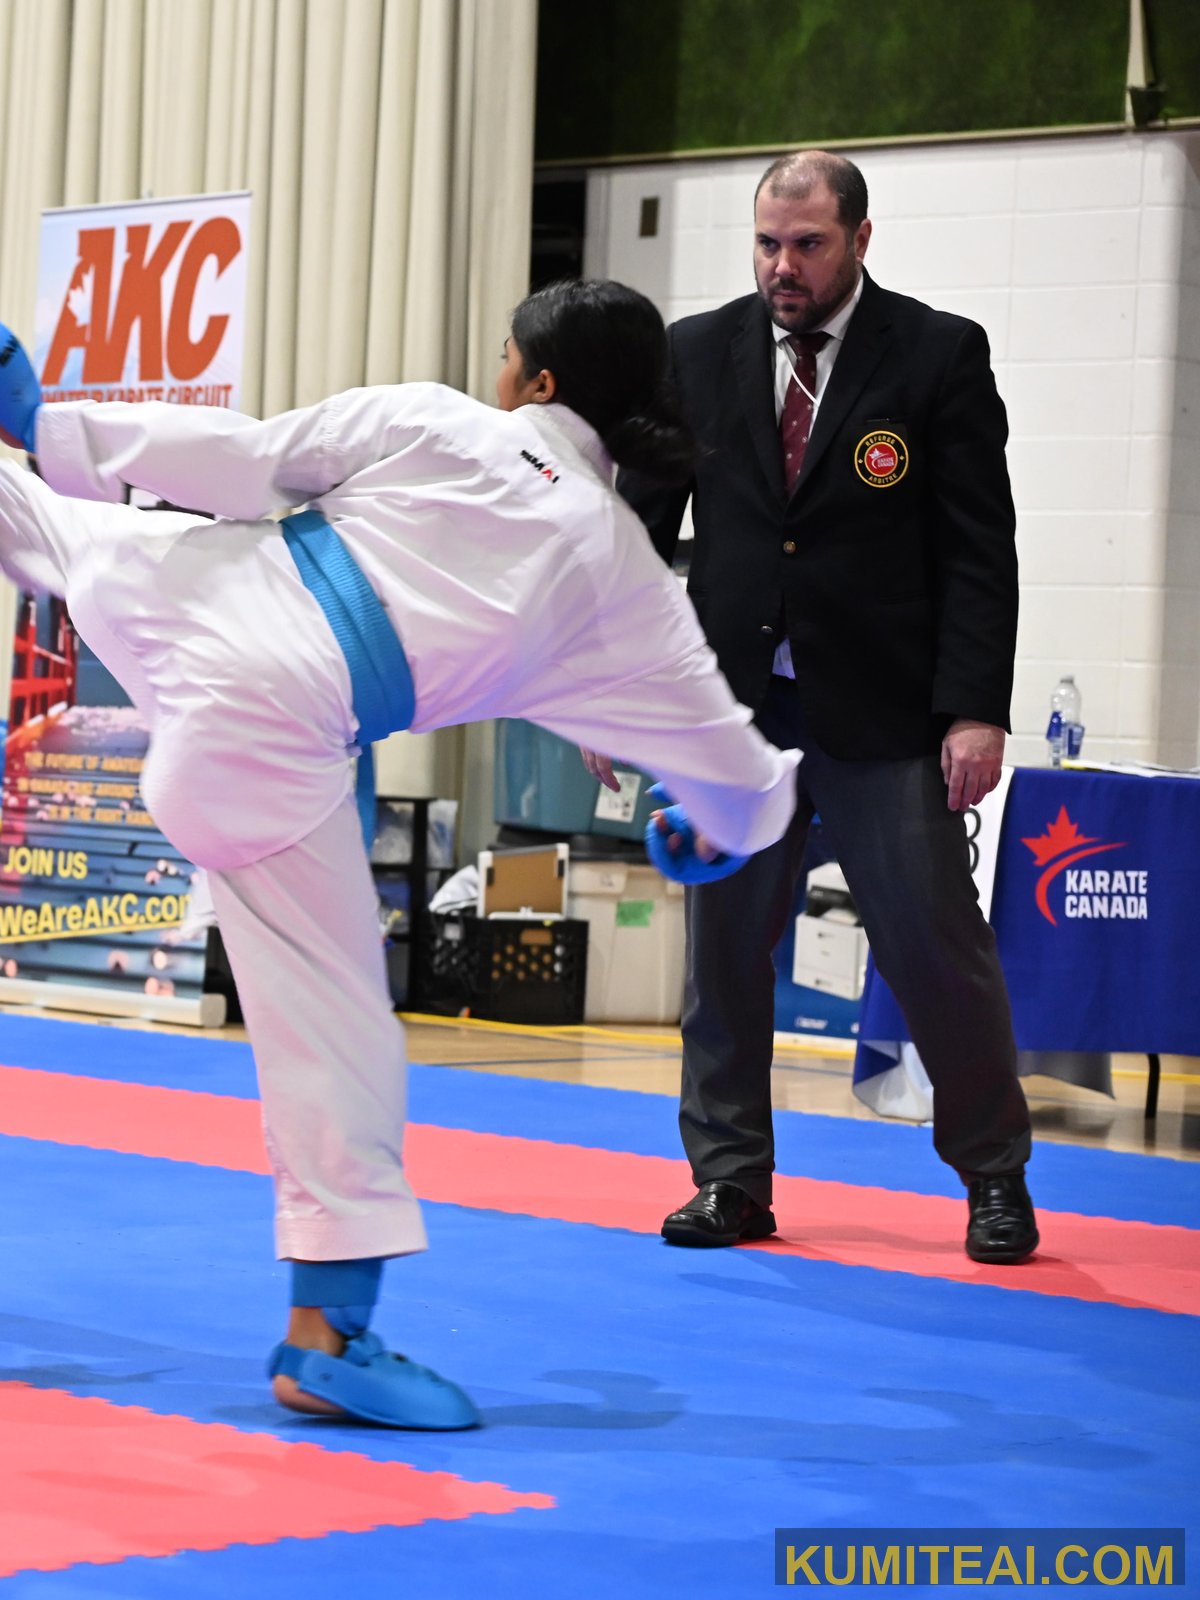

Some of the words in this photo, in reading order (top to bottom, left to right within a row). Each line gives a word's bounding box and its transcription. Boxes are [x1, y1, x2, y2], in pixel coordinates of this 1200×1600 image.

[40, 216, 242, 386] AKC
[4, 847, 53, 876] JOIN
[58, 851, 88, 879] US
[1065, 870, 1148, 895] KARATE
[1065, 895, 1148, 920] CANADA
